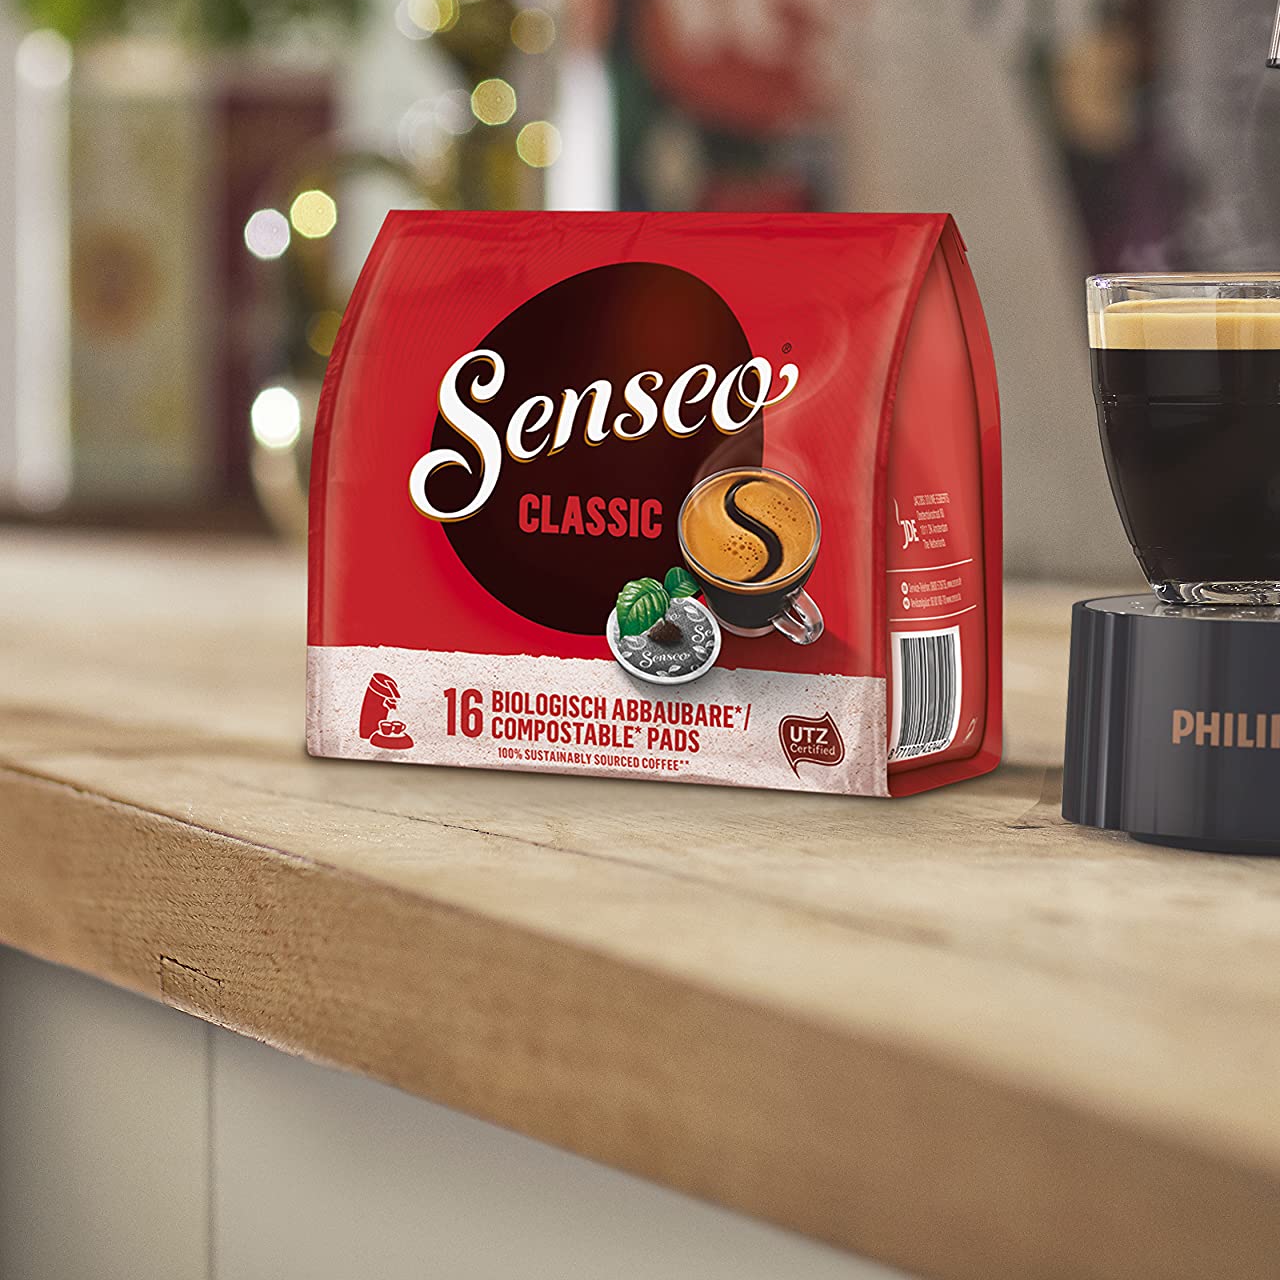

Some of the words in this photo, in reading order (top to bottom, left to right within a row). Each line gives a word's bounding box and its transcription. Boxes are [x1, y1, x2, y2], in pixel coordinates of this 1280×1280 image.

[408, 349, 800, 522] Senseo
[518, 493, 663, 540] CLASSIC
[900, 519, 920, 550] JDE
[639, 649, 691, 669] Senseo
[443, 687, 484, 739] 16
[491, 690, 607, 720] BIOLOGISCH
[647, 727, 700, 753] PADS
[790, 726, 829, 745] UTZ
[790, 743, 836, 756] Certified
[498, 747, 523, 760] 100%
[524, 748, 592, 765] SUSTAINABLY
[594, 753, 640, 768] SOURCED
